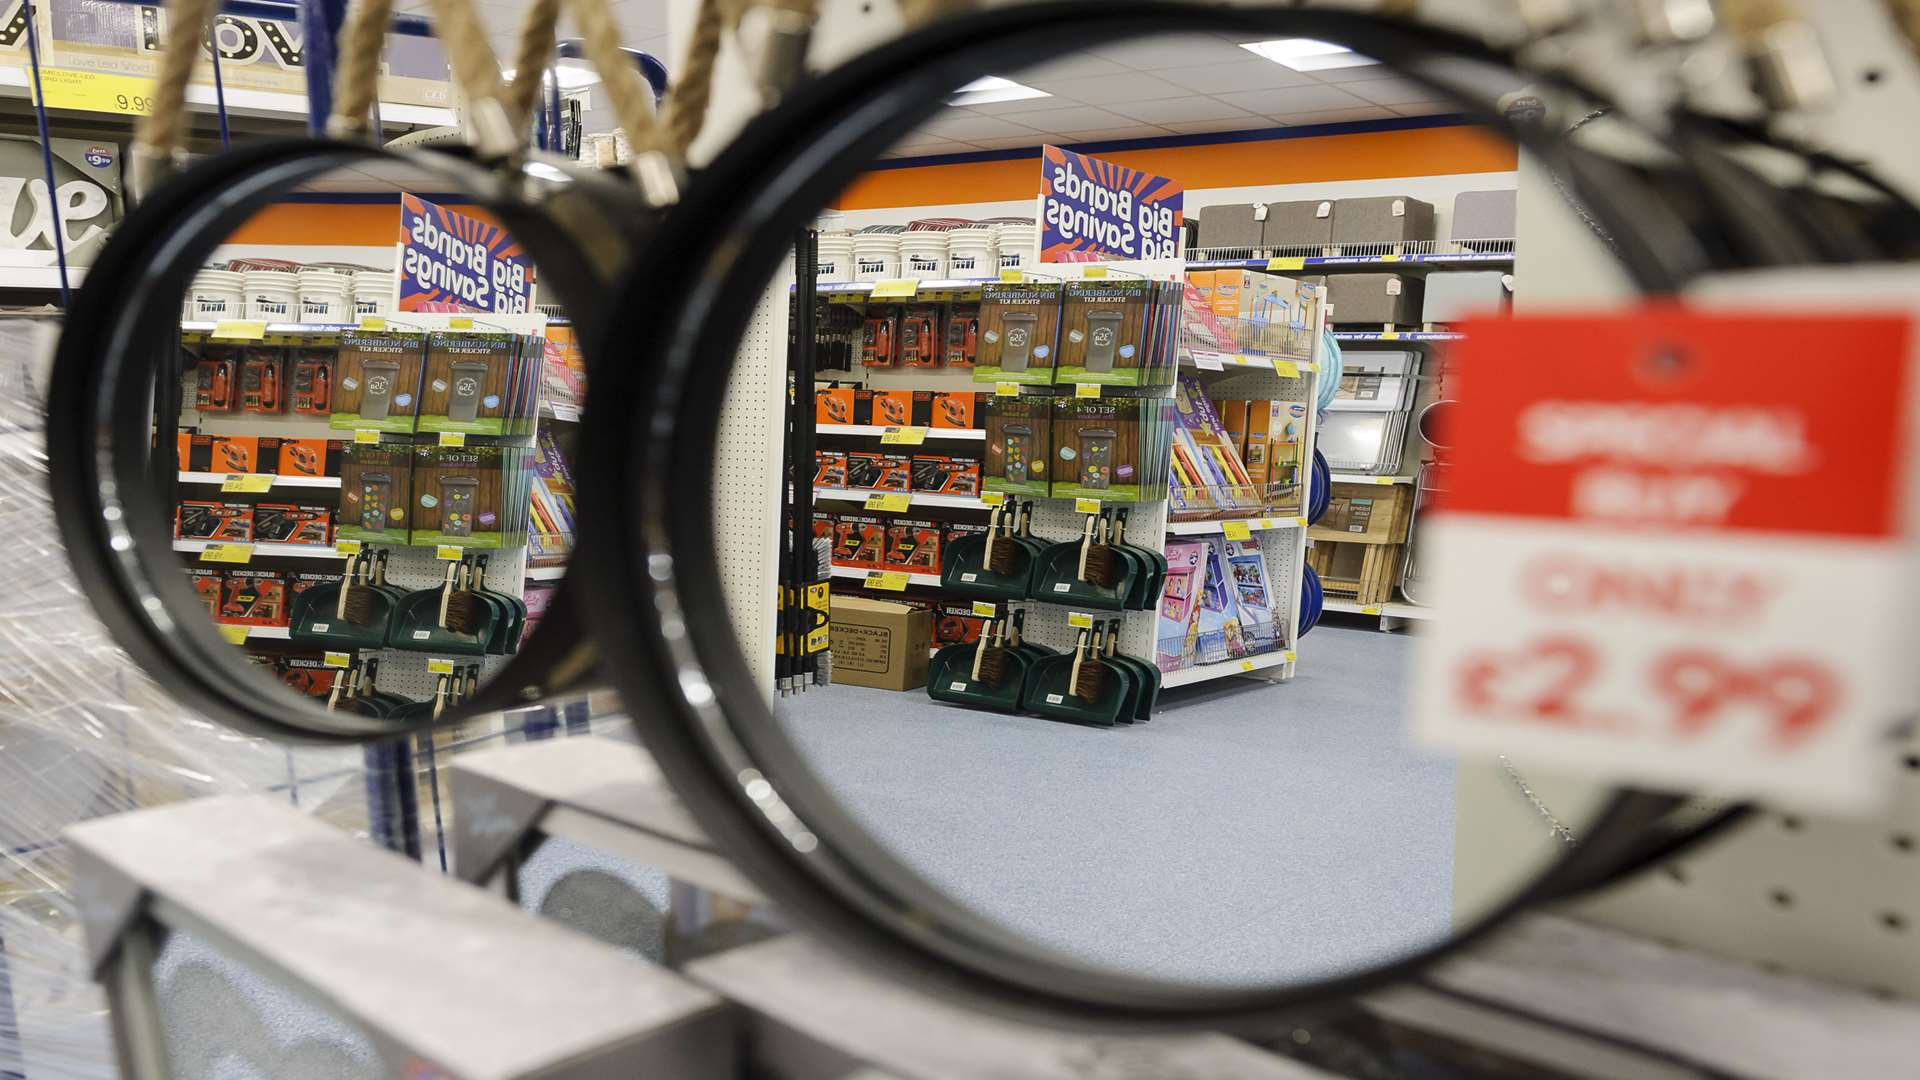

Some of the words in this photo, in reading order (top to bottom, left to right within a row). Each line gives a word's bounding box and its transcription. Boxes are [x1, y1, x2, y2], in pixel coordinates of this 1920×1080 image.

[70, 55, 96, 67] Love
[98, 58, 120, 70] Led
[1454, 634, 1850, 752] £2.99
